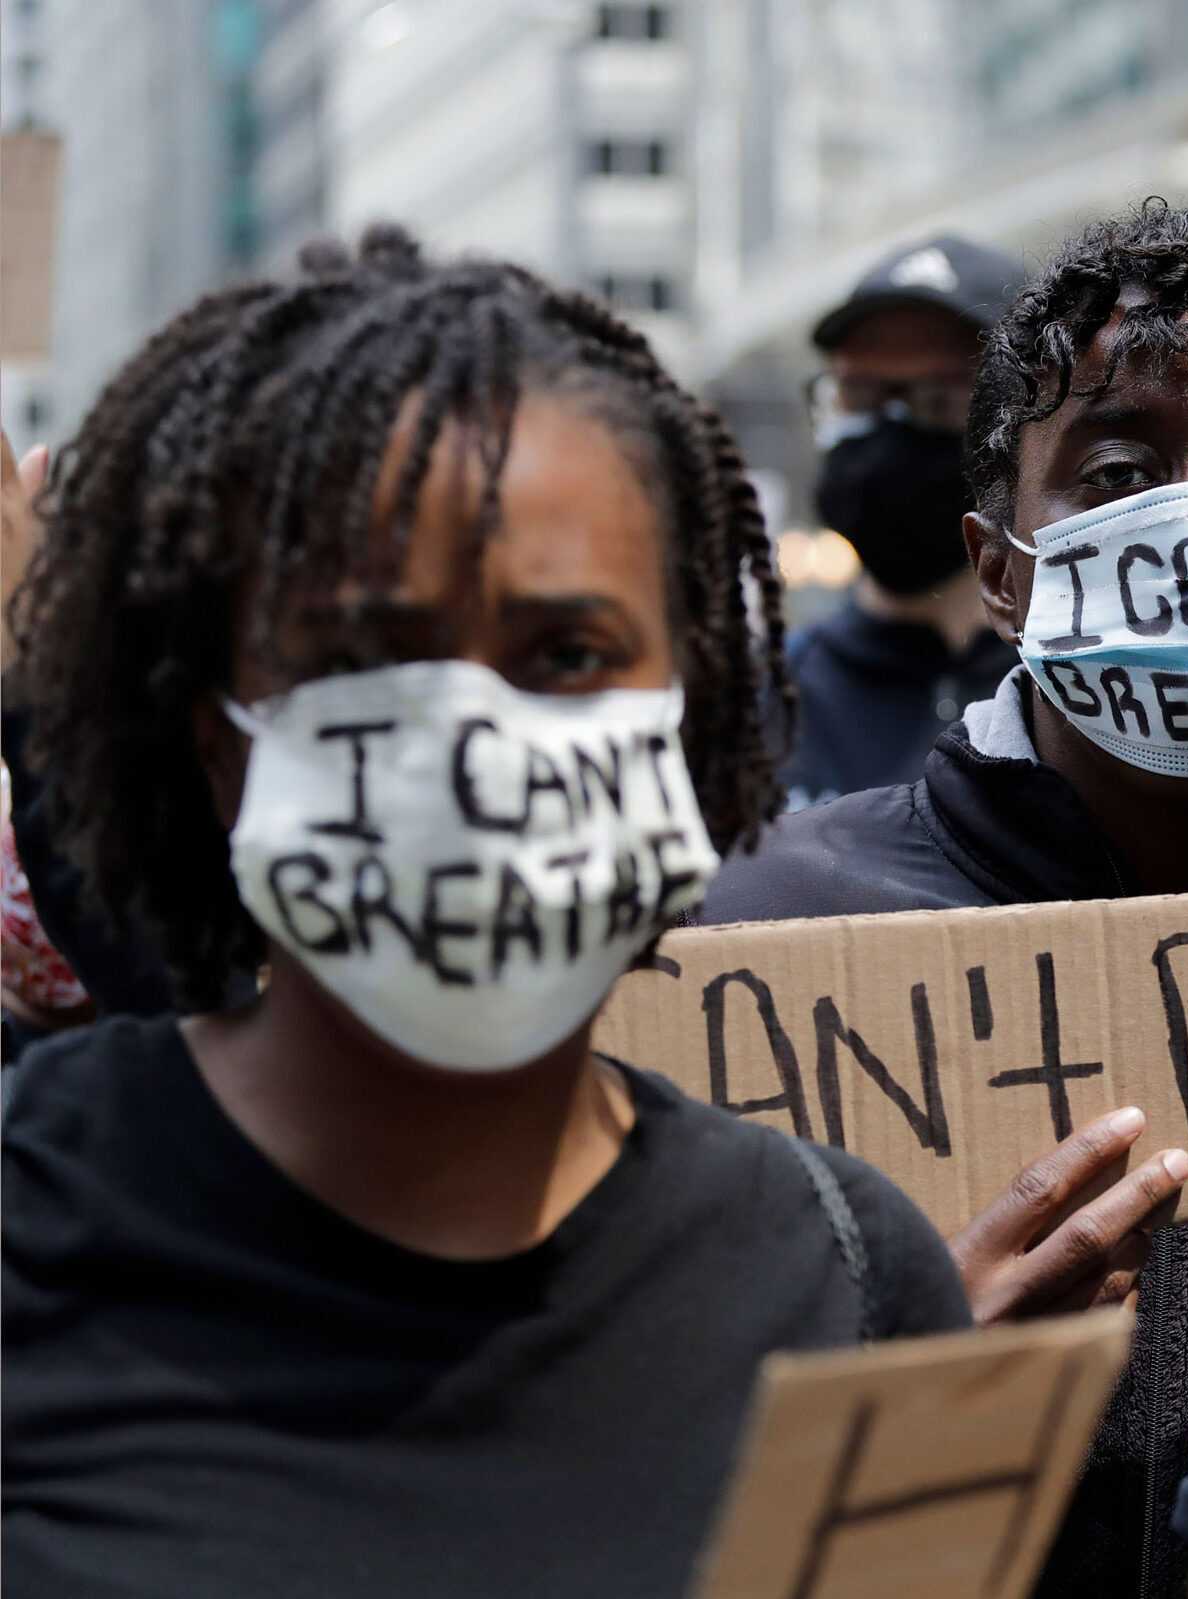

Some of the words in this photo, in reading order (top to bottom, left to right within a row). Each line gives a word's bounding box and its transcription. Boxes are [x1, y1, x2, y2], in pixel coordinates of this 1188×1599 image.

[1038, 542, 1104, 652] I
[305, 718, 398, 846] I
[265, 832, 698, 988] BREATHE
[632, 951, 1104, 1157] AN't
